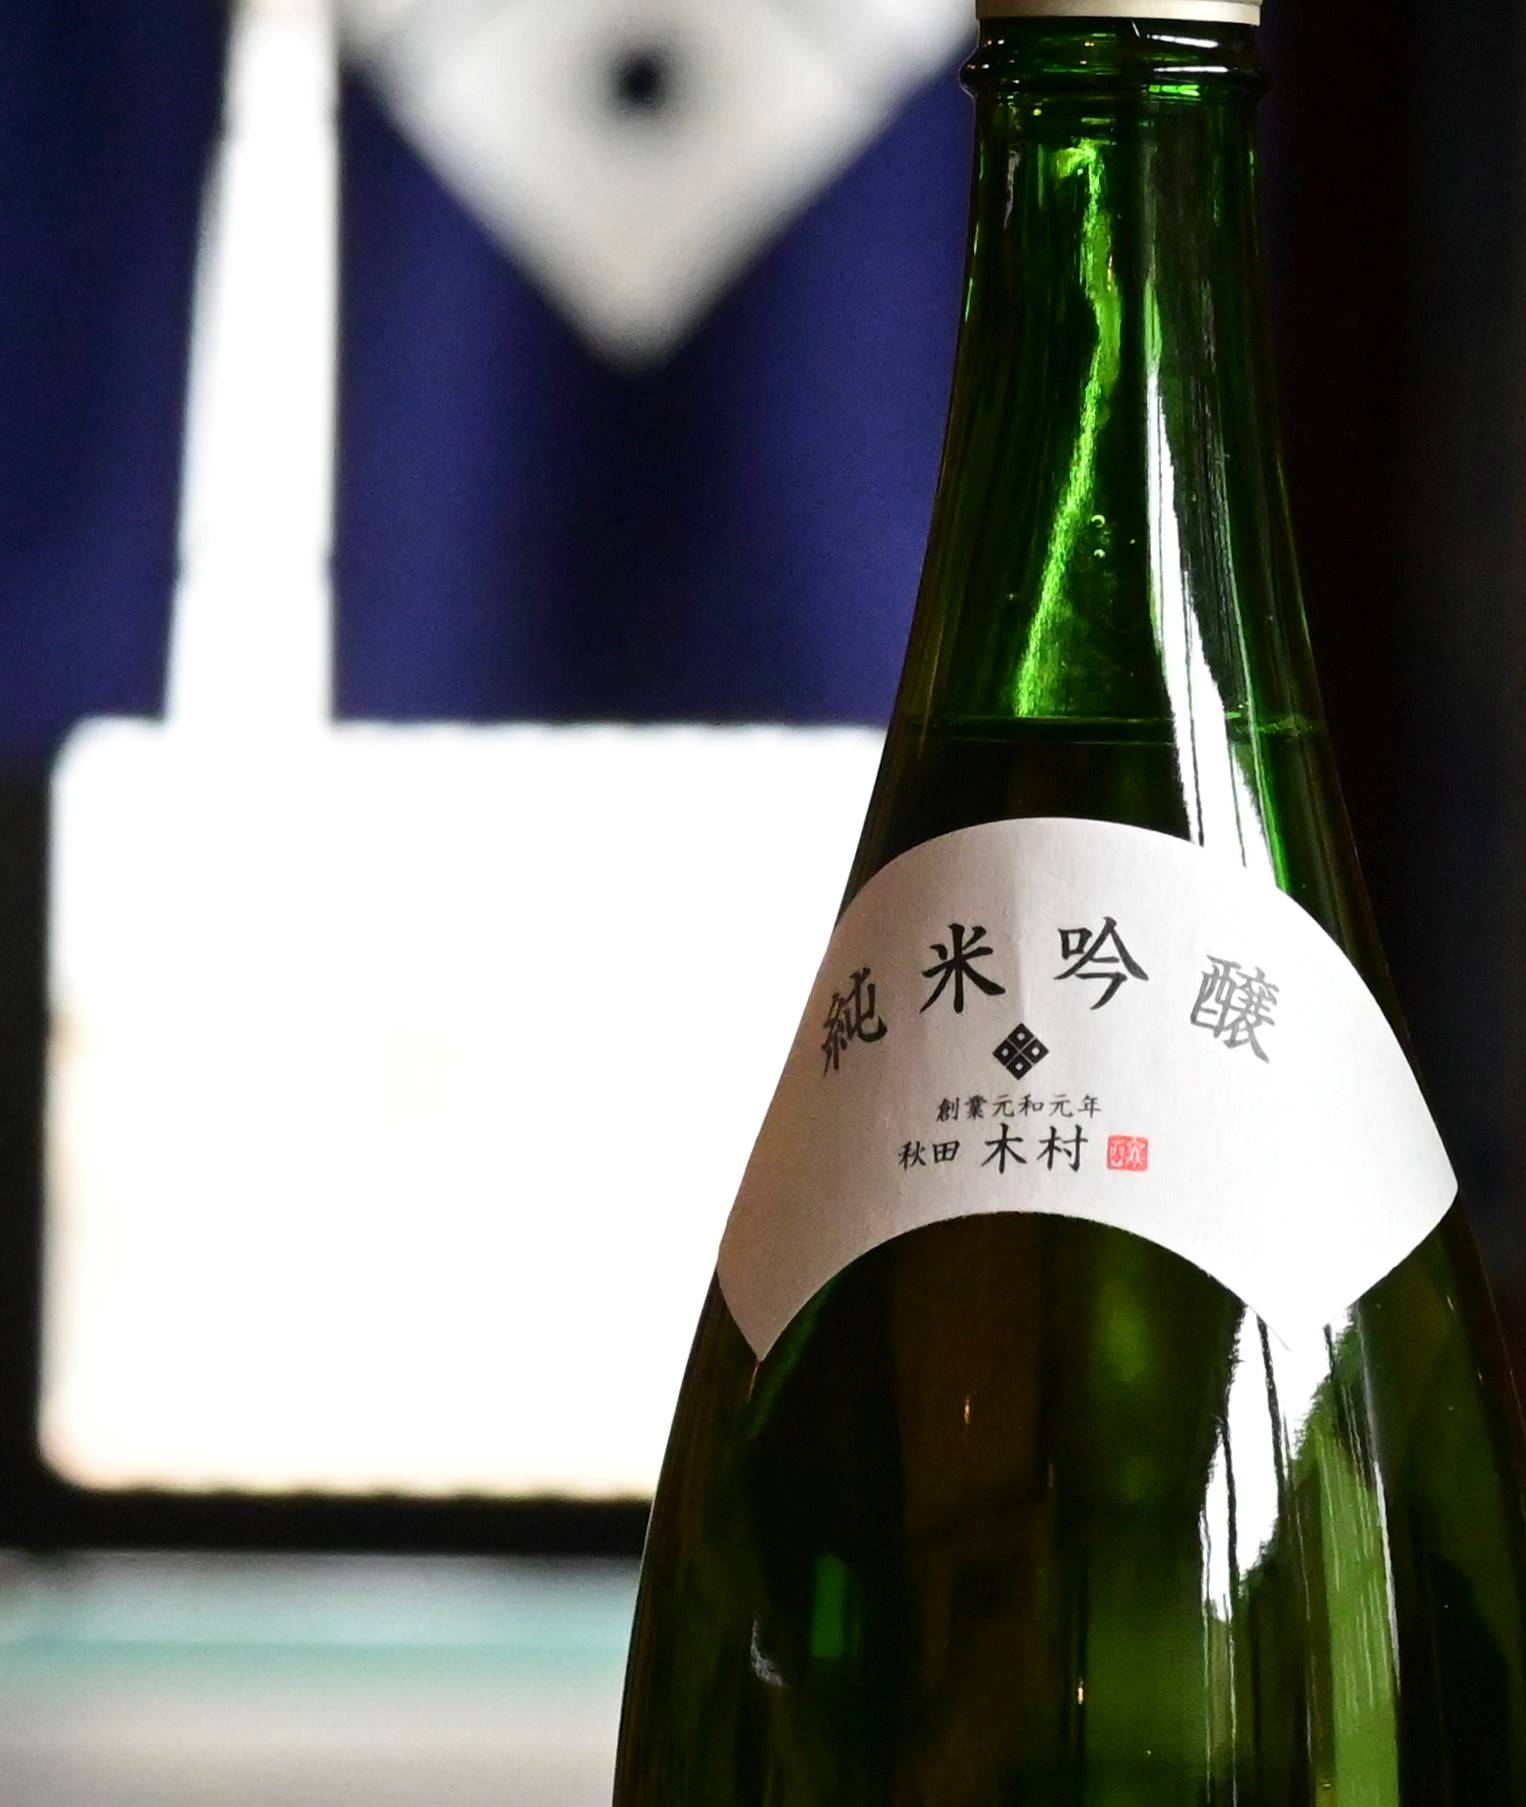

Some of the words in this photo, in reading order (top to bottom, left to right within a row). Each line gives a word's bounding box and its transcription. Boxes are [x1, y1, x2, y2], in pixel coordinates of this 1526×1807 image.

[935, 1093, 1102, 1123] 創業元和元年
[898, 1140, 960, 1171] 秋田
[980, 1123, 1090, 1175] 木村
